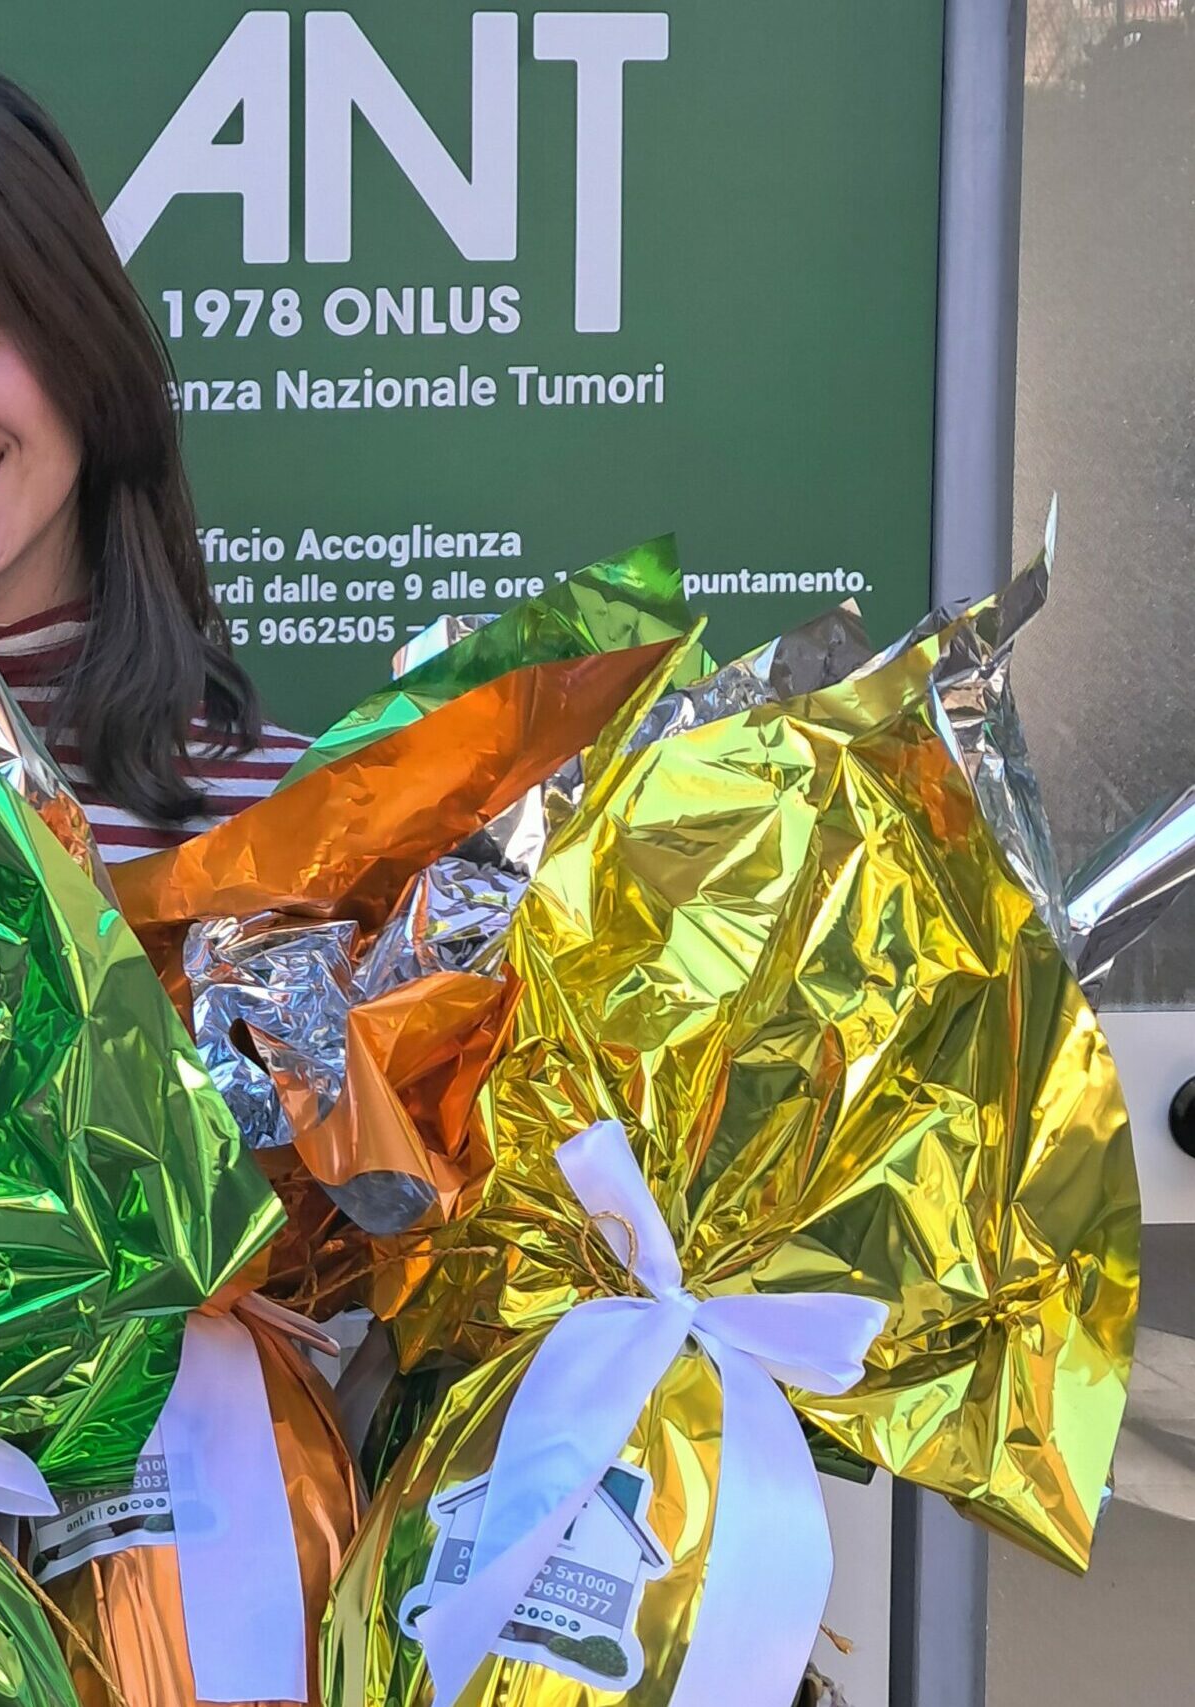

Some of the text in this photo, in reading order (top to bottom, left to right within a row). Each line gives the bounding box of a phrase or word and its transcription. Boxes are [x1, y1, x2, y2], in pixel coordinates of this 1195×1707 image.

[101, 10, 670, 333] ANT
[162, 285, 522, 339] 1978 ONLUS
[276, 366, 496, 409] Nazionale
[508, 363, 666, 405] Tumori
[295, 524, 522, 568] Accoglienza
[208, 574, 254, 604] rdì
[263, 574, 338, 603] dalle
[345, 578, 396, 600] ore
[405, 574, 423, 600] 9
[431, 571, 487, 599] alle
[495, 576, 544, 598] ore
[258, 615, 396, 645] 9662505
[66, 1510, 96, 1533] ant.it
[555, 1564, 617, 1597] 5x1000
